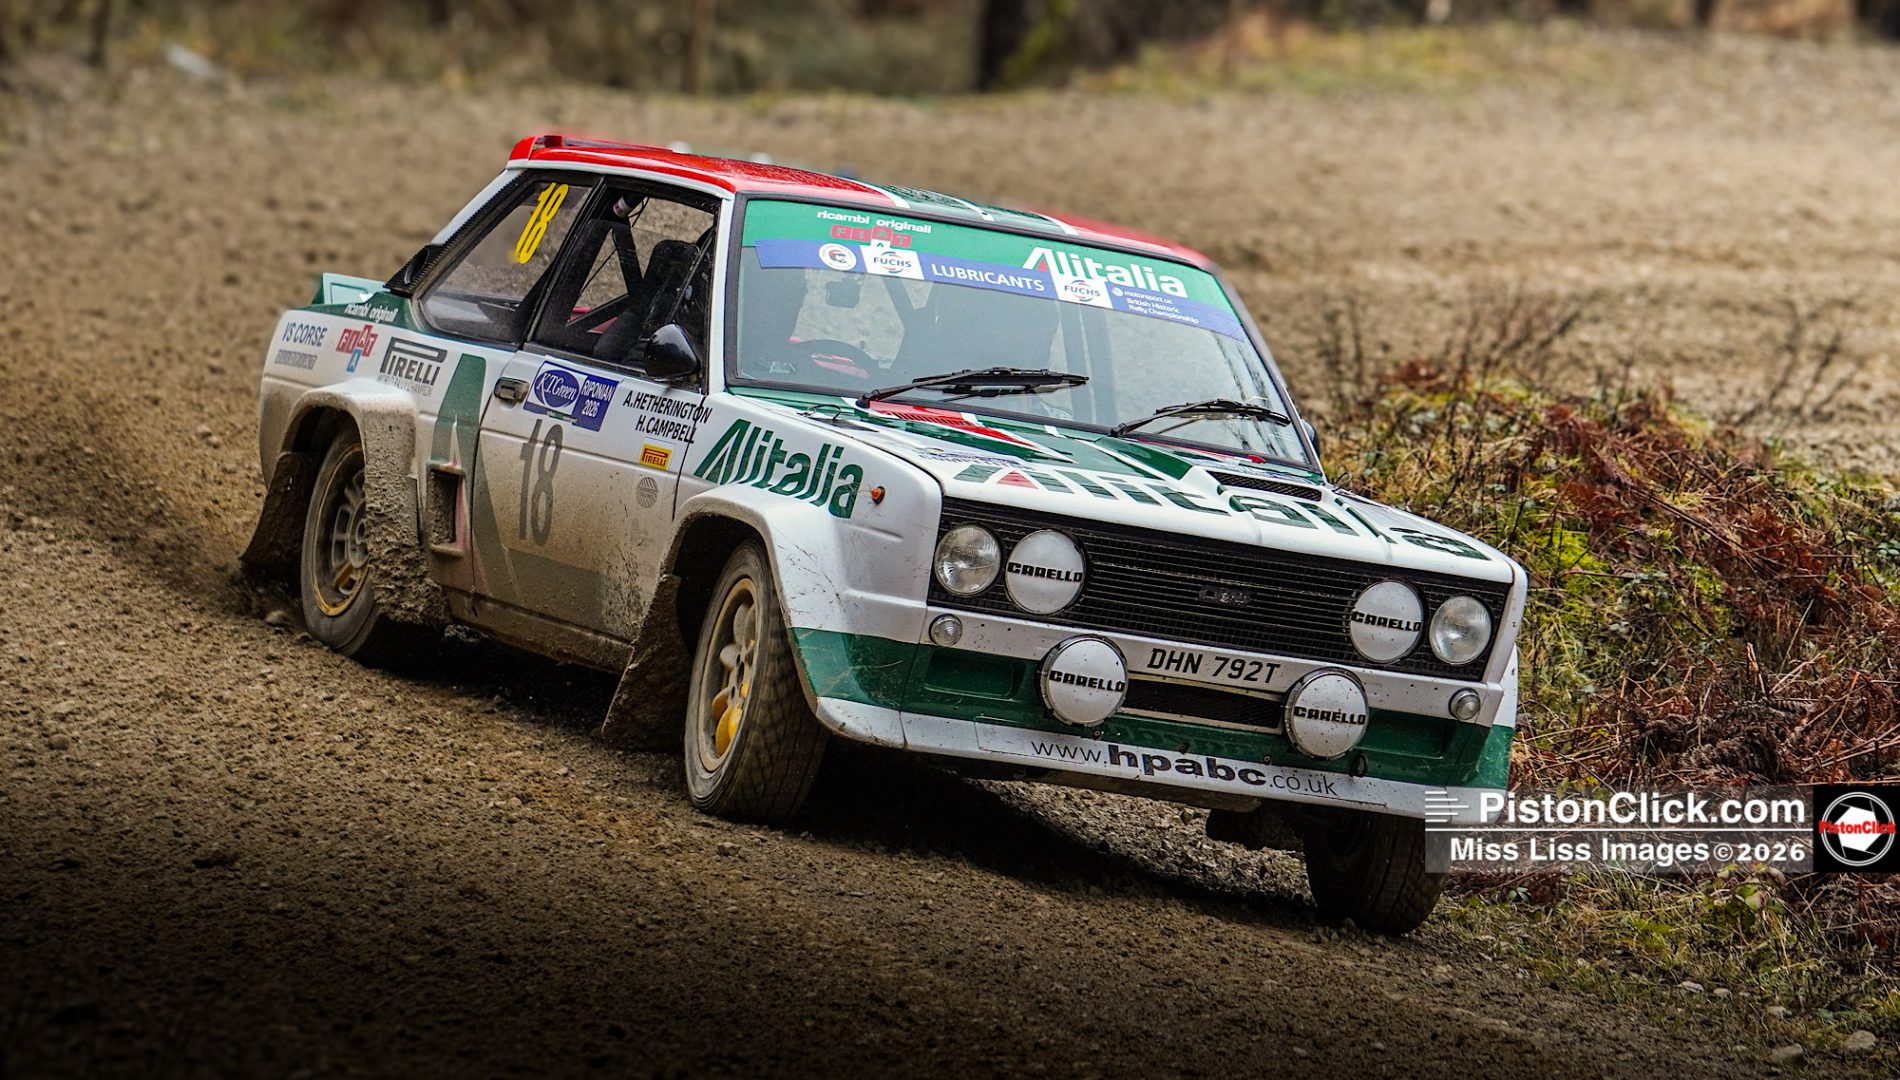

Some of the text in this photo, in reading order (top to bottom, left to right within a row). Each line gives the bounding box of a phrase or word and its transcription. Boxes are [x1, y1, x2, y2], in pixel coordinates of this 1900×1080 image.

[513, 182, 569, 264] 18
[817, 210, 870, 225] ricambi
[832, 226, 912, 248] FIAT
[873, 256, 912, 268] FUCHS
[1023, 247, 1188, 298] Alitalia
[931, 263, 1045, 292] LUBRICANTS
[1064, 284, 1101, 298] FUCHS
[293, 323, 328, 347] CORSE
[337, 324, 378, 357] FIAT
[380, 336, 448, 386] PIRELLI
[581, 379, 616, 402] RIPONIAN
[581, 398, 600, 418] 2026
[622, 390, 713, 424] A.HETHERINGTON
[635, 414, 697, 444] H.CAMPBELL
[641, 447, 669, 467] PIRELLI
[694, 418, 864, 519] Alitalia
[519, 418, 564, 546] 18
[1007, 561, 1084, 583] CARELLO
[1350, 610, 1423, 632] CARELLO
[1147, 647, 1282, 684] DHN 792T
[1049, 670, 1125, 693] CARELLO
[1294, 705, 1366, 726] CARELLO
[1030, 740, 1340, 797] www.hpabc.co.uk
